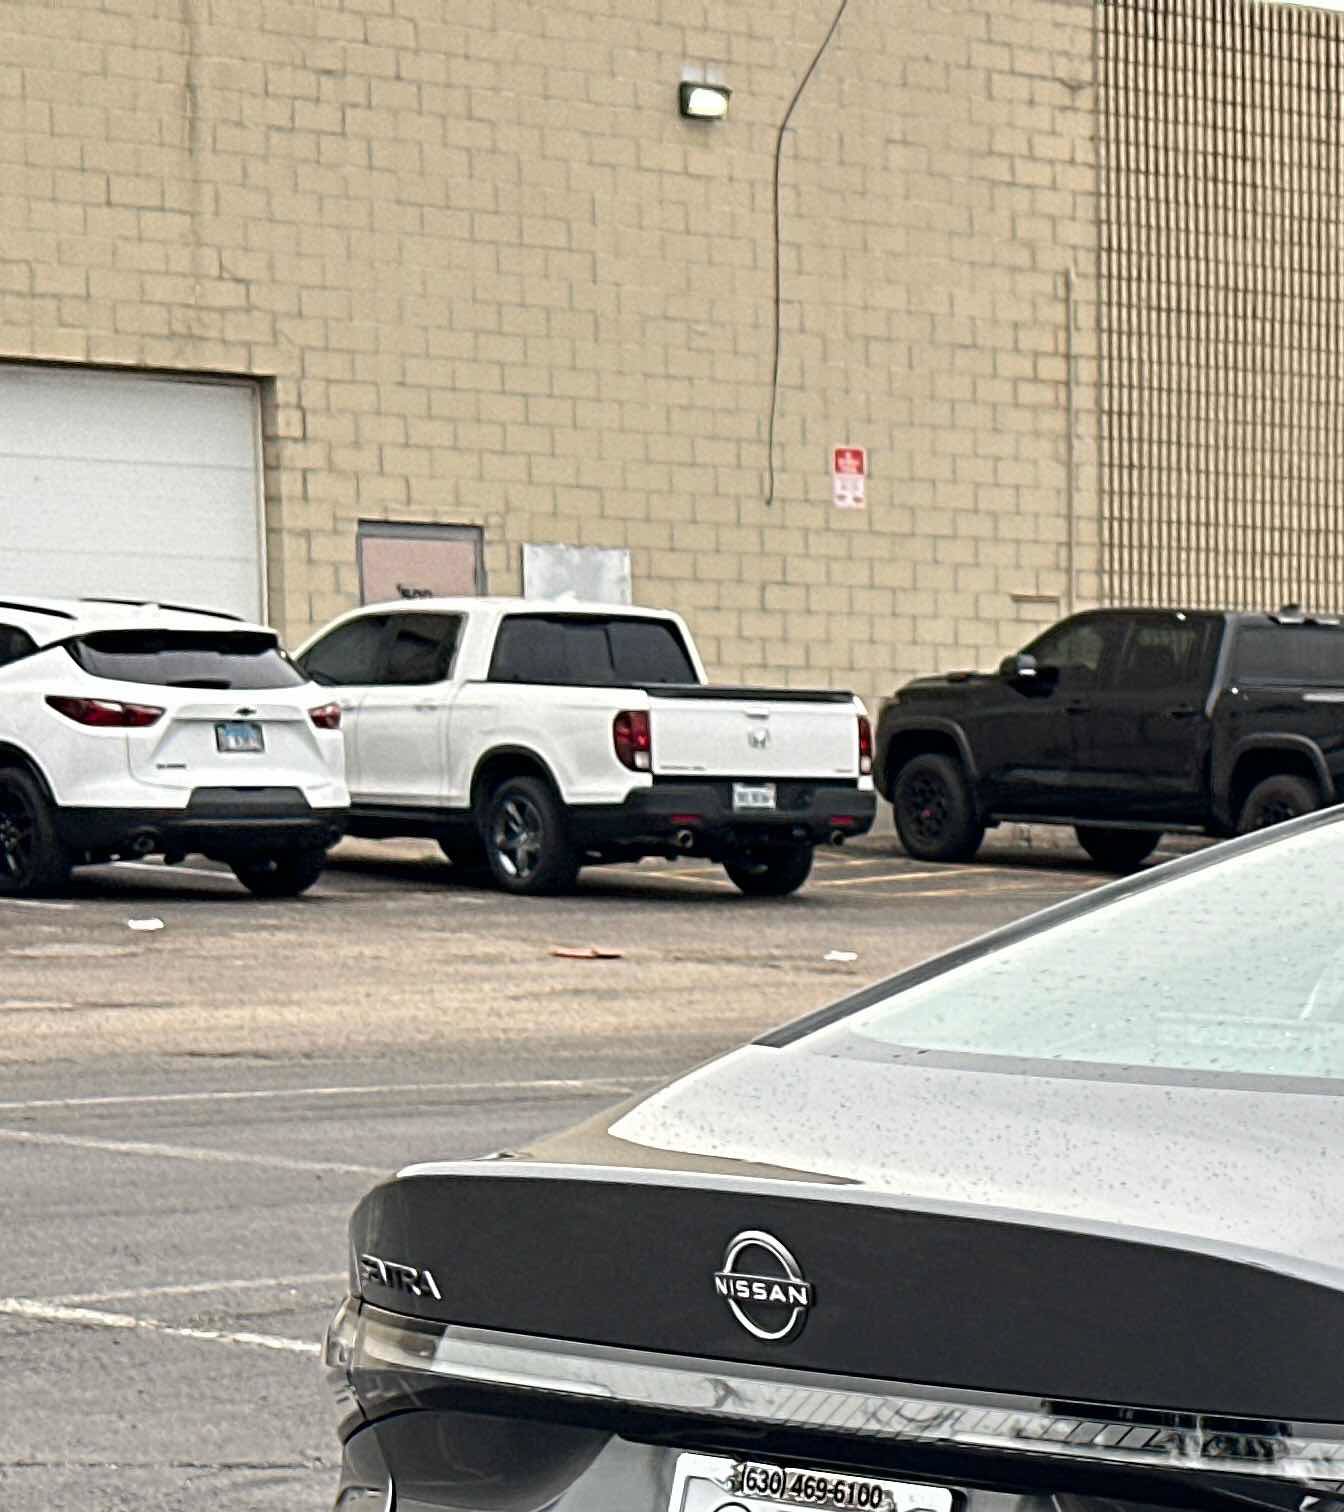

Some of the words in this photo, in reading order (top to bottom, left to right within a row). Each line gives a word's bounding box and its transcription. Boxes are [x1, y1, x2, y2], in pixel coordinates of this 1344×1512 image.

[714, 1276, 808, 1305] NISSAN
[740, 1464, 787, 1498] (630)
[789, 1470, 883, 1509] 469-6100
